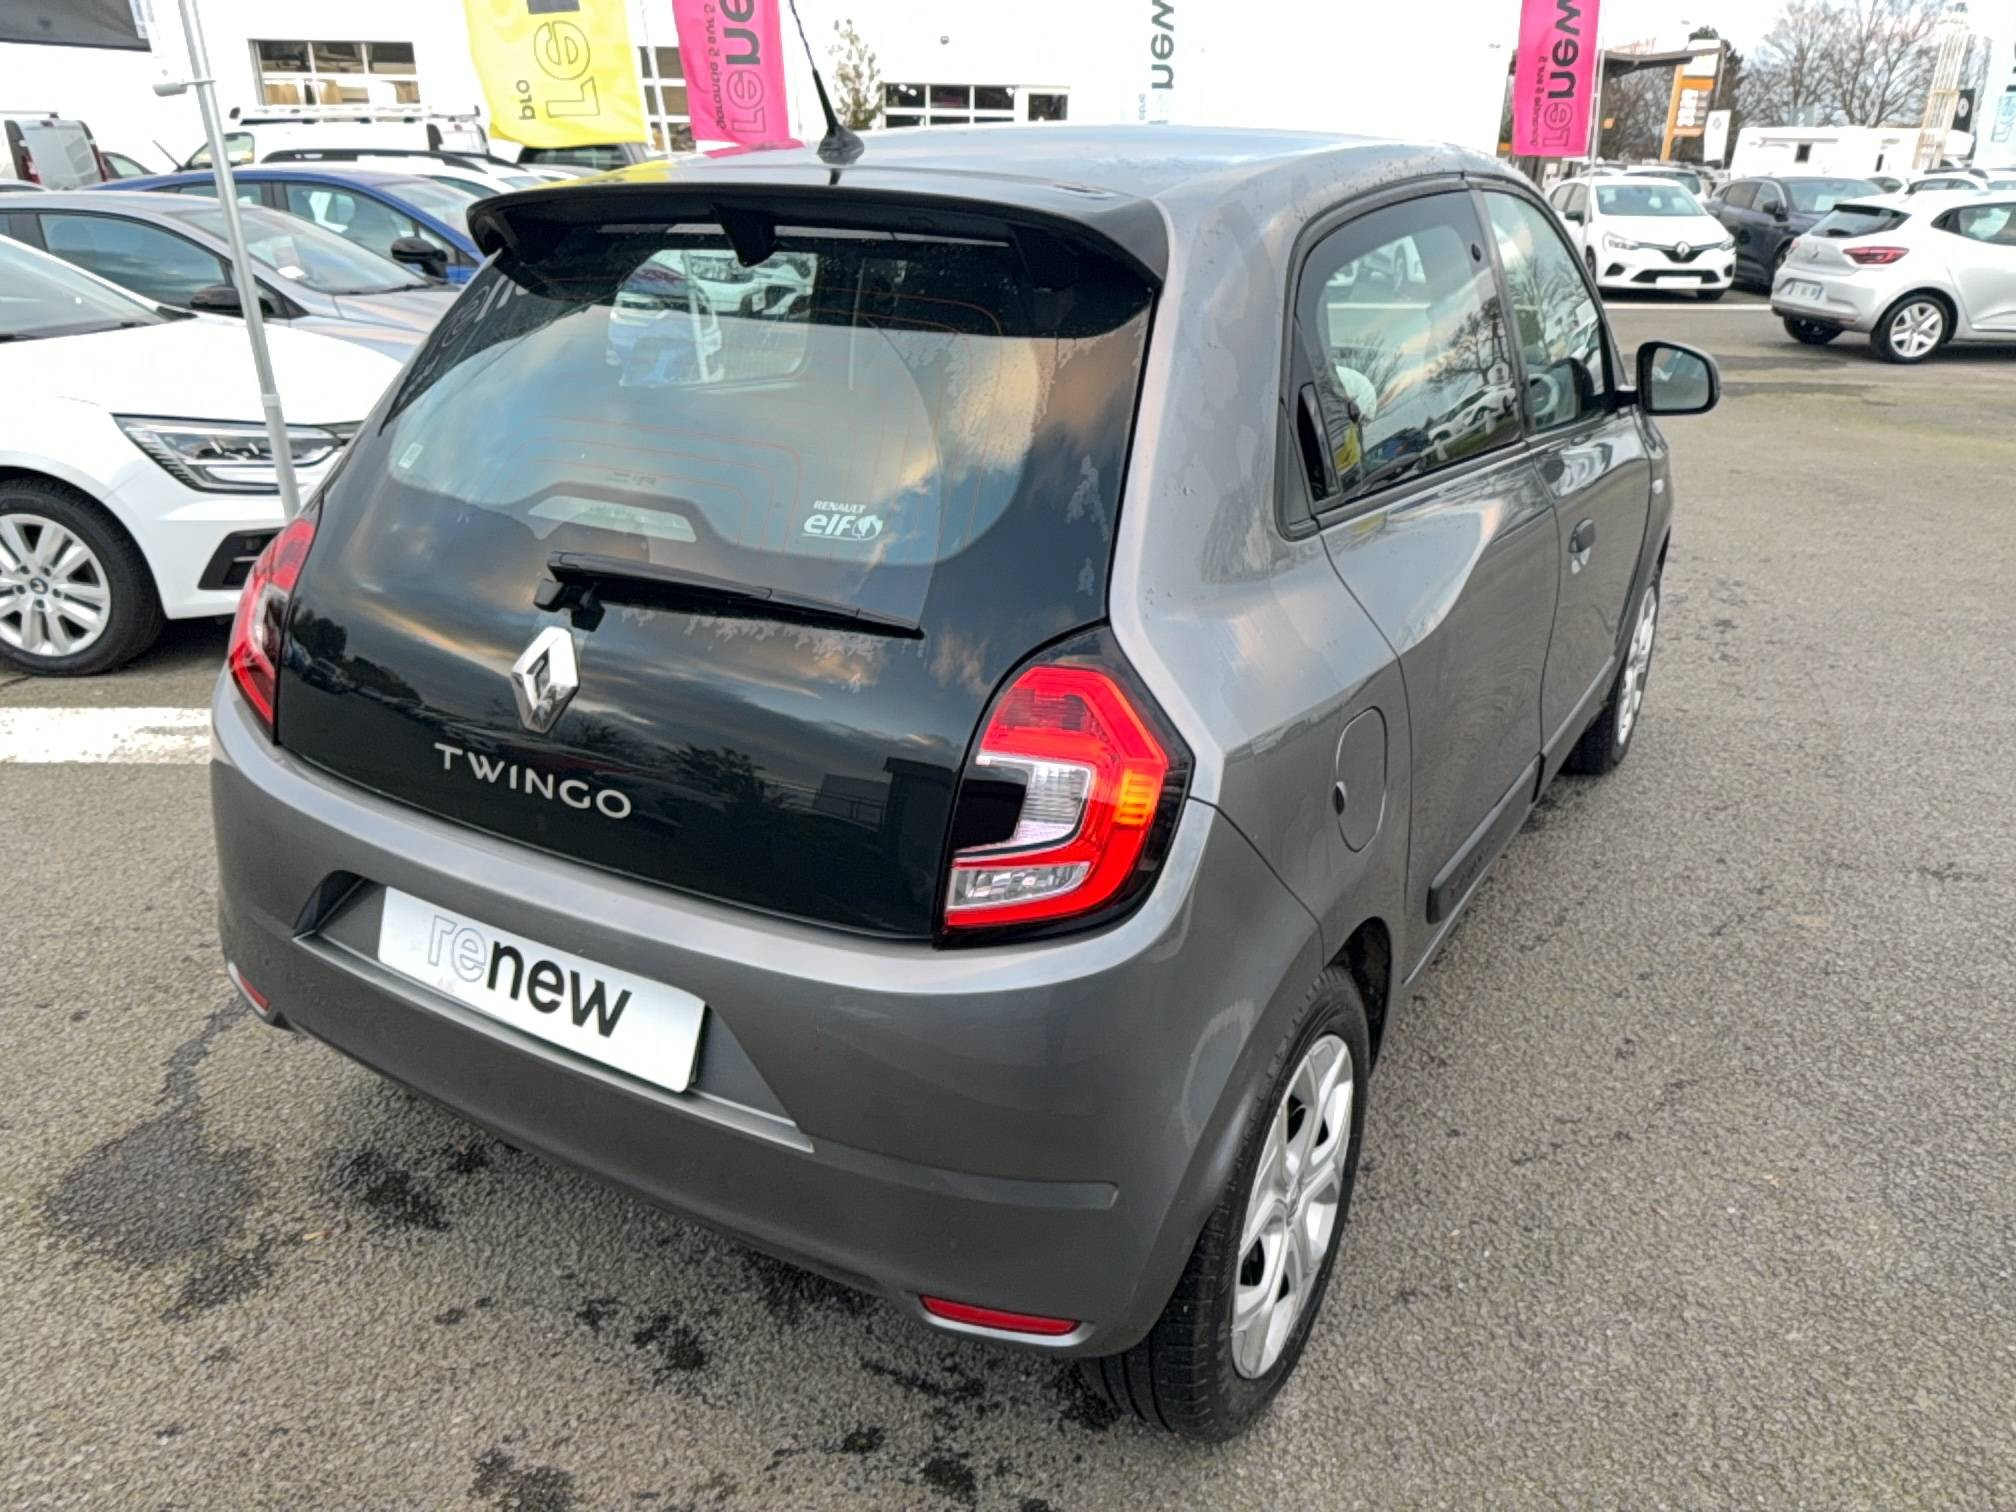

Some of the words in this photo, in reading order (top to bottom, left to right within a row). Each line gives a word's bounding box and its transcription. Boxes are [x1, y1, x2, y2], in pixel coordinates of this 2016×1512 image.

[803, 514, 857, 536] elf
[813, 500, 866, 514] RENAULT
[434, 742, 632, 819] TWINGO
[427, 914, 633, 1039] renew
